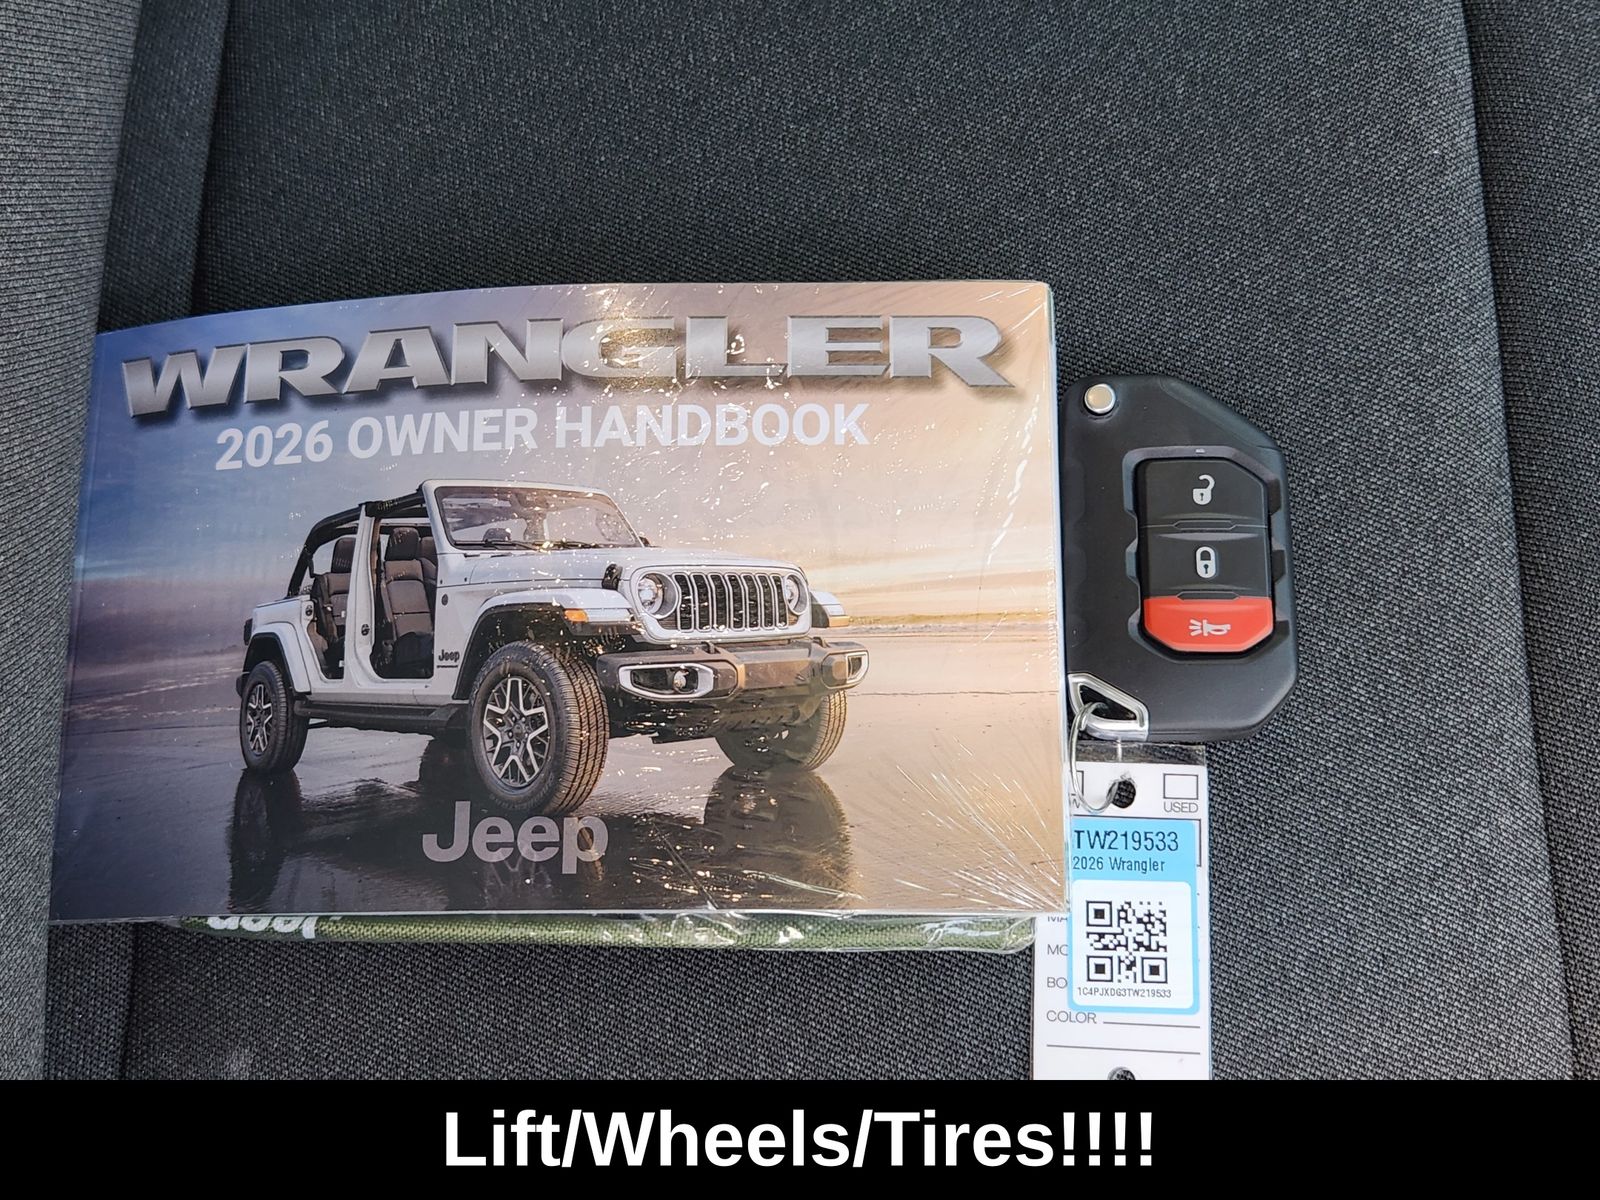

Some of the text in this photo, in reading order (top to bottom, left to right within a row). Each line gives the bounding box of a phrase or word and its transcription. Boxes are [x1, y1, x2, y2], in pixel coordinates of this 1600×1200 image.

[121, 315, 1015, 418] WRANGLER
[215, 402, 870, 471] 2026 OWNER HANDBOOK
[438, 648, 460, 663] Jeep
[1162, 801, 1199, 813] USED
[421, 801, 609, 875] Jeep
[1073, 829, 1179, 852] TW219533
[1072, 855, 1166, 875] 2026 Wrangler
[1046, 1010, 1098, 1025] COLOR
